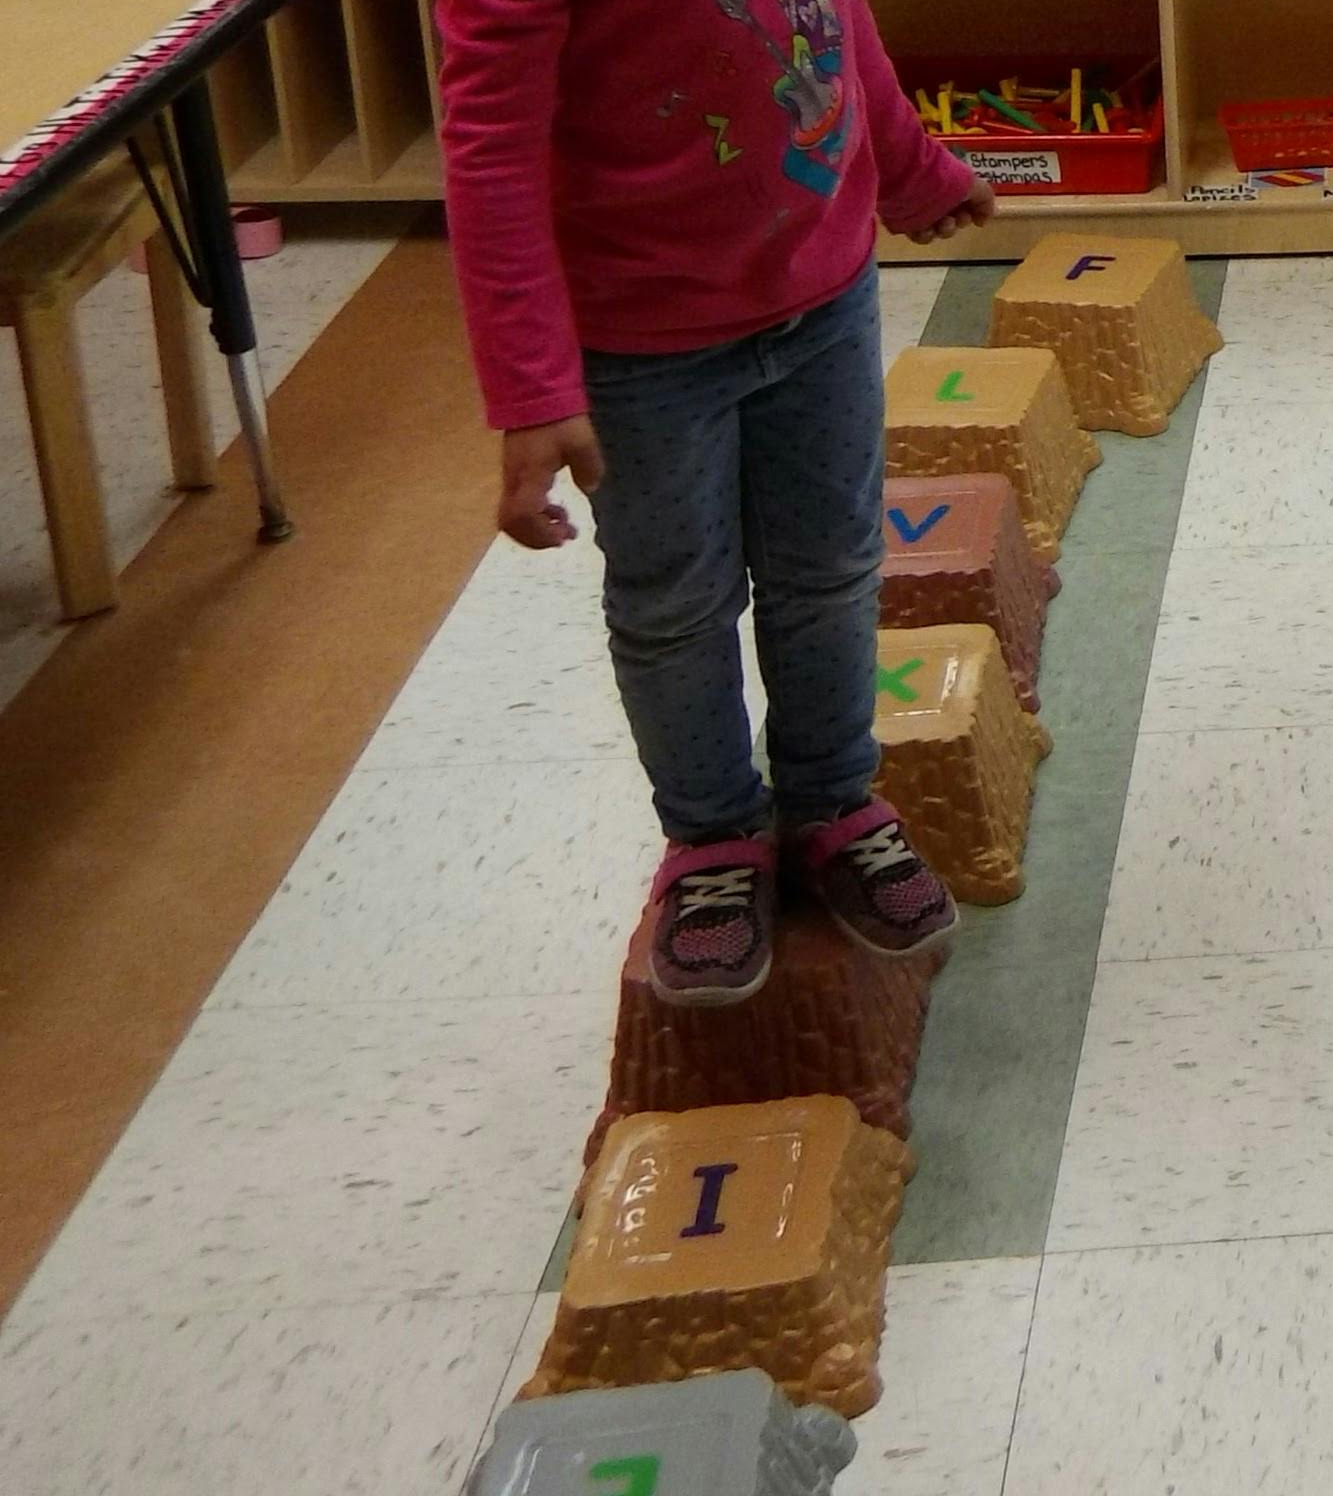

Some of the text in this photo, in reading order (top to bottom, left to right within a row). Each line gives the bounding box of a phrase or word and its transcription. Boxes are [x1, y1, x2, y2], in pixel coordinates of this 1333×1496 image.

[970, 153, 1049, 171] Stampers
[1065, 255, 1116, 280] F
[935, 370, 975, 401] L
[887, 504, 951, 542] V
[679, 1164, 738, 1237] I
